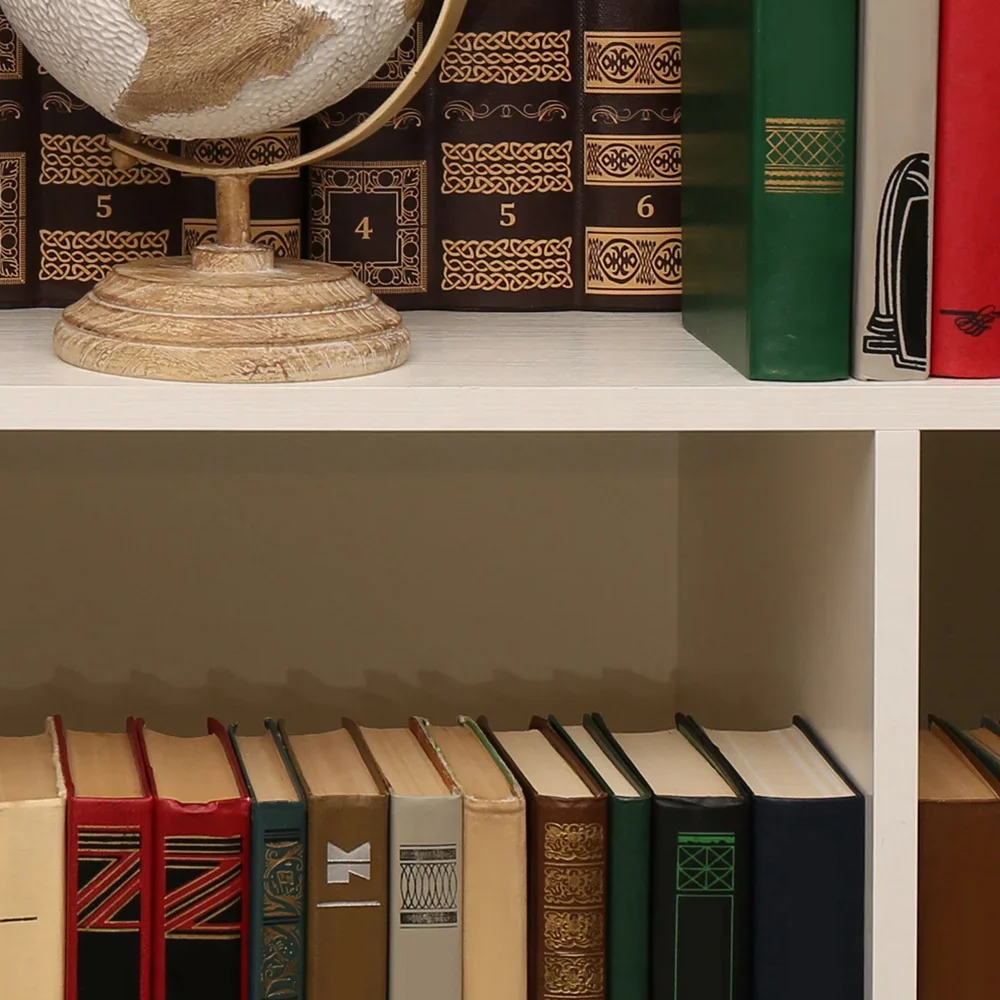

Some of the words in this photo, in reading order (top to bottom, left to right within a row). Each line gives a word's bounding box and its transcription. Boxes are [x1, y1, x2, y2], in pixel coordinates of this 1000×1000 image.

[96, 195, 112, 218] 5
[499, 203, 517, 227] 5
[637, 195, 655, 218] 6
[354, 216, 373, 240] 4
